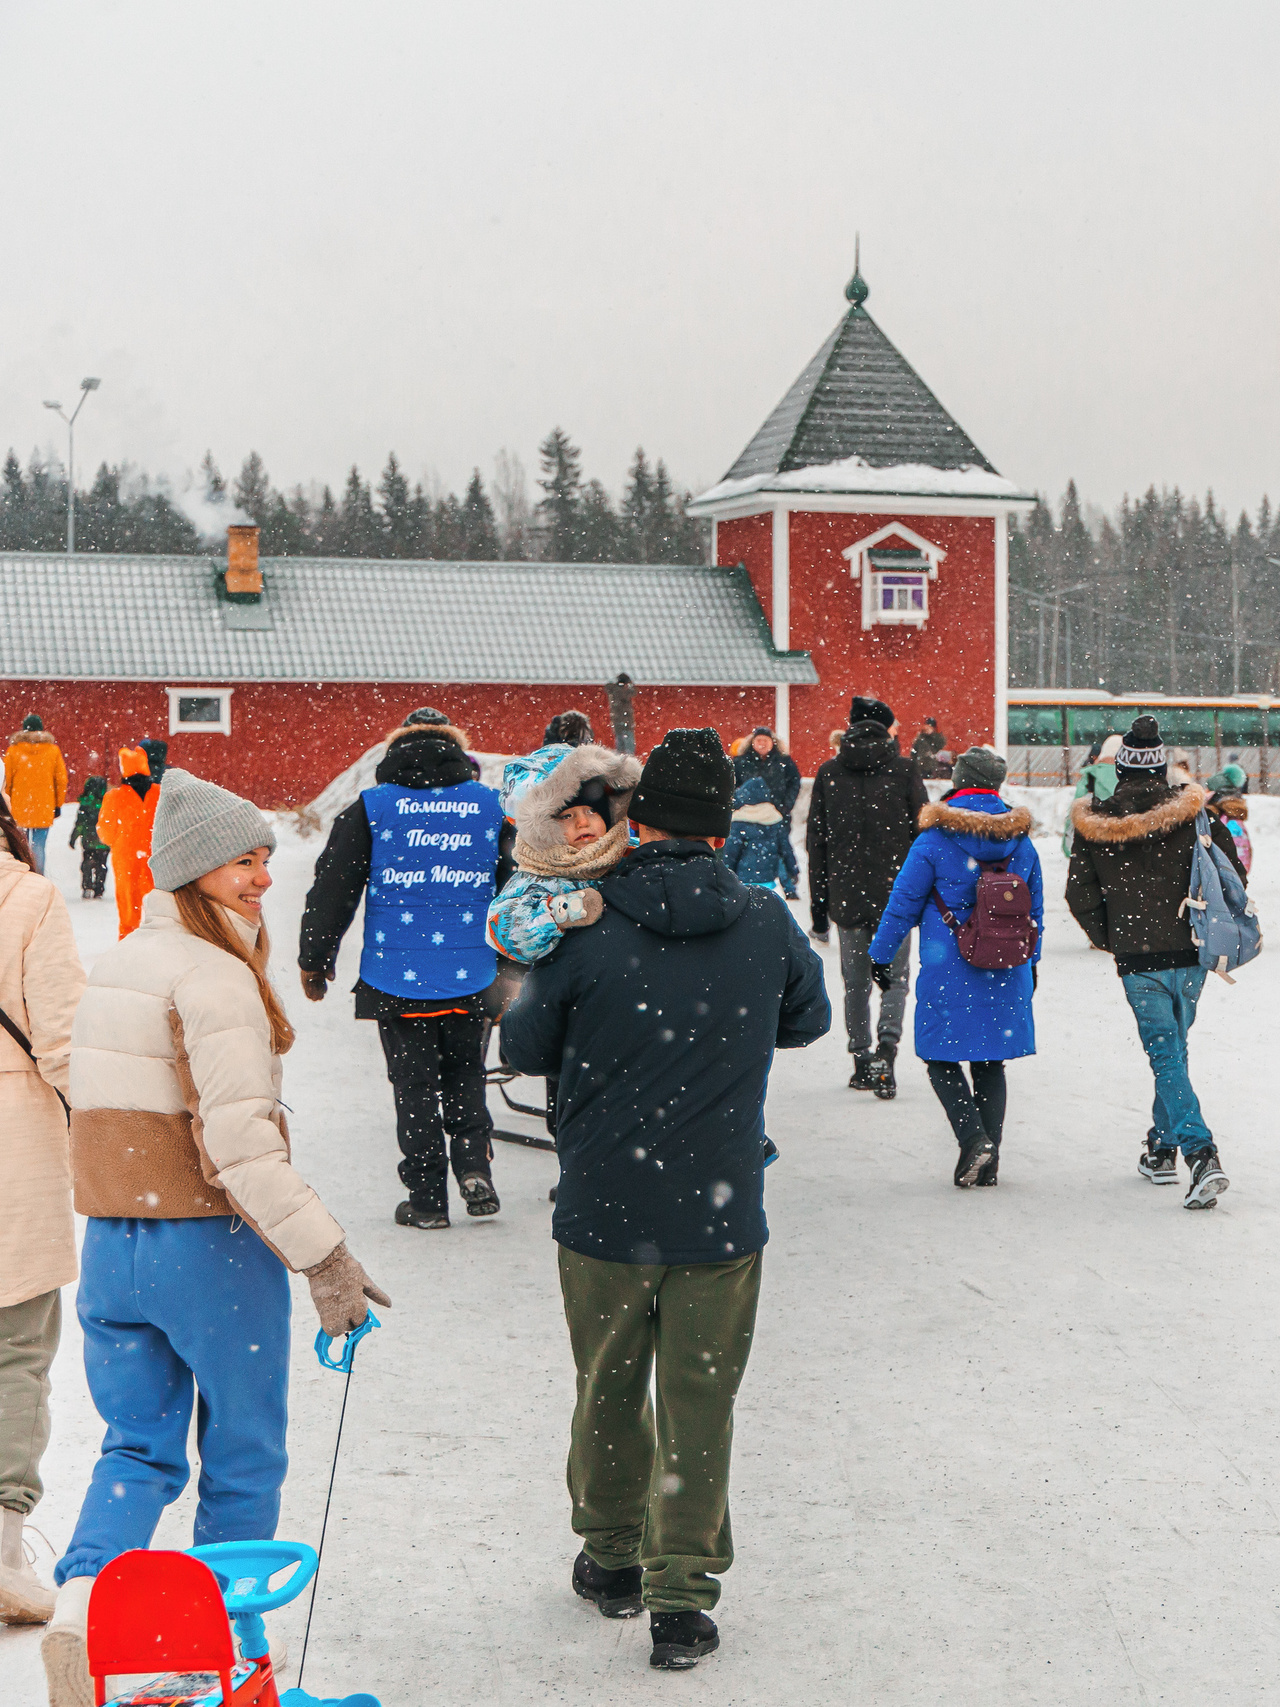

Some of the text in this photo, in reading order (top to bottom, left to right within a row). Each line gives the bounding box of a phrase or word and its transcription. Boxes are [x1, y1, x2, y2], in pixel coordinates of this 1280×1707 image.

[396, 797, 481, 818] Команда
[406, 829, 473, 851] Поезда
[382, 865, 491, 888] Деда Мороза
